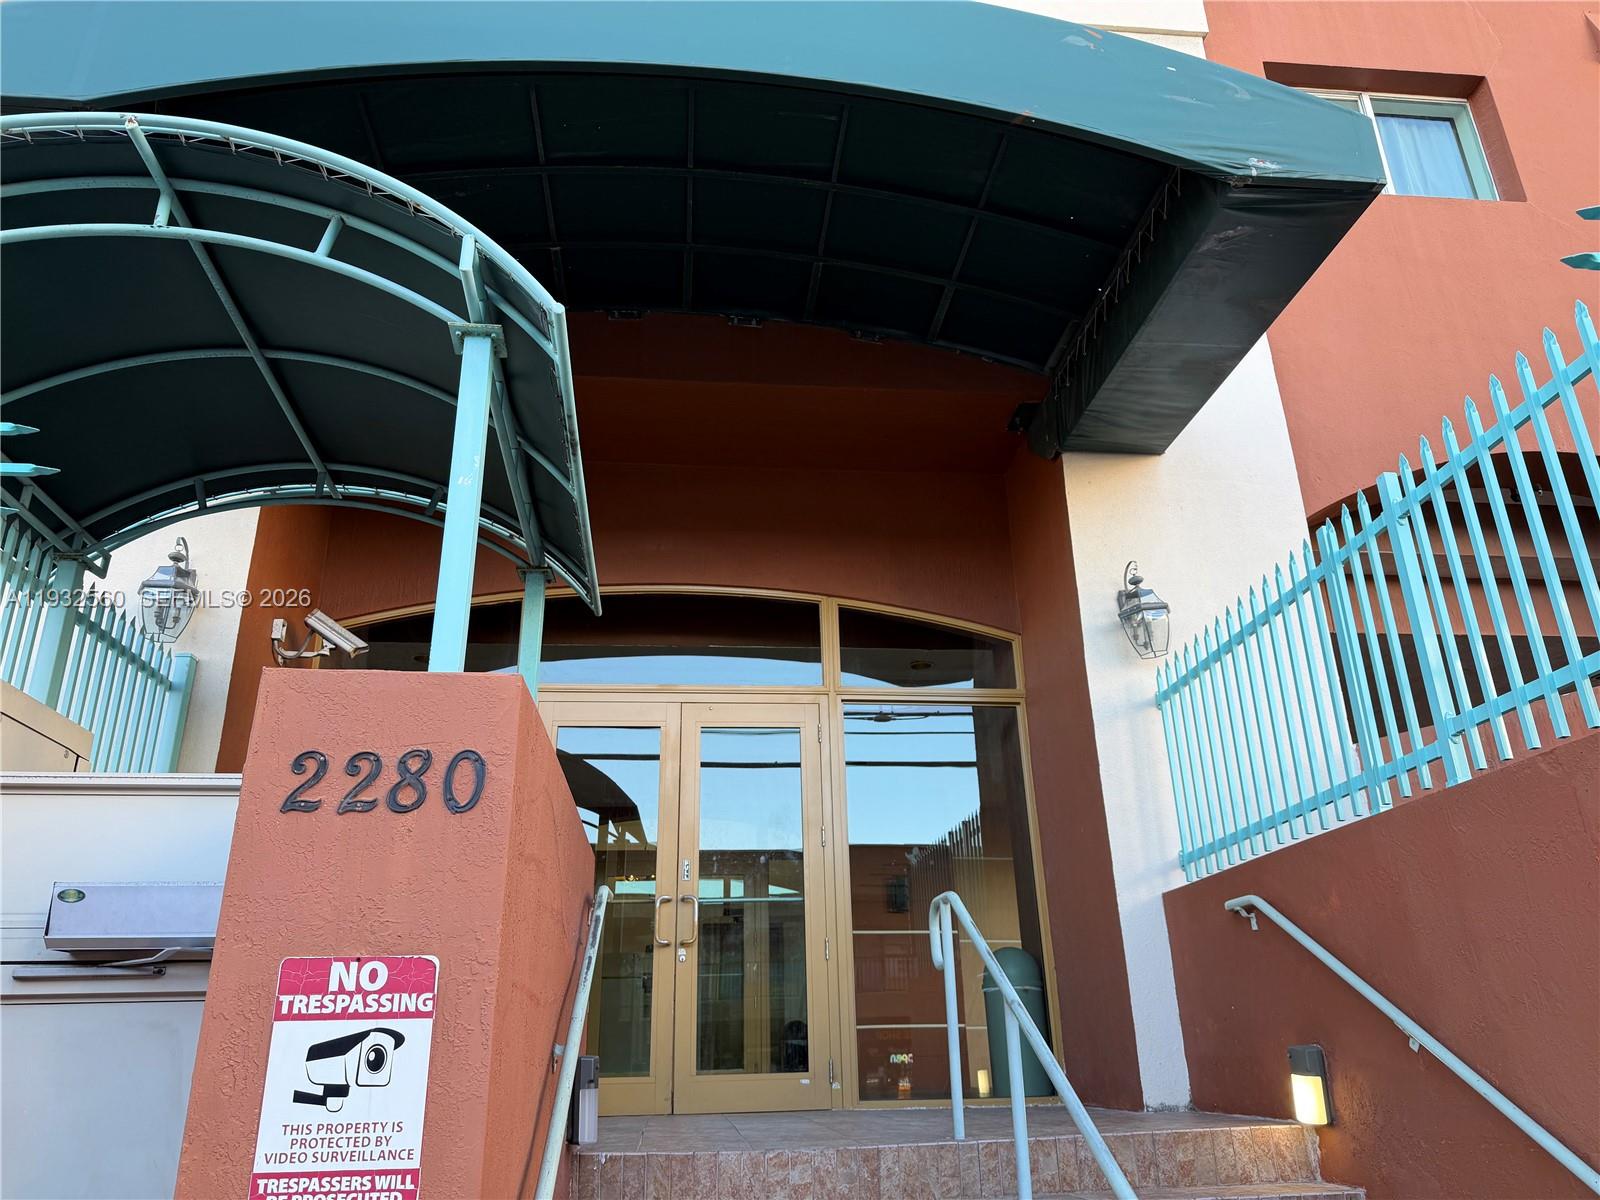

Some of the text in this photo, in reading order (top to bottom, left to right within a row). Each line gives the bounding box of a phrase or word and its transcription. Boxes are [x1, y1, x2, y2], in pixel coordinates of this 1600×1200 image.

[280, 749, 486, 815] 2280
[328, 960, 389, 993] NO
[279, 993, 434, 1015] TRESPASSING
[282, 1121, 404, 1136] THIS PROPERTY IS
[290, 1135, 393, 1149] PROTECTED BY
[264, 1148, 415, 1164] VIDEO SURVEILLANCE
[257, 1174, 415, 1194] TRESPASSERS WILL
